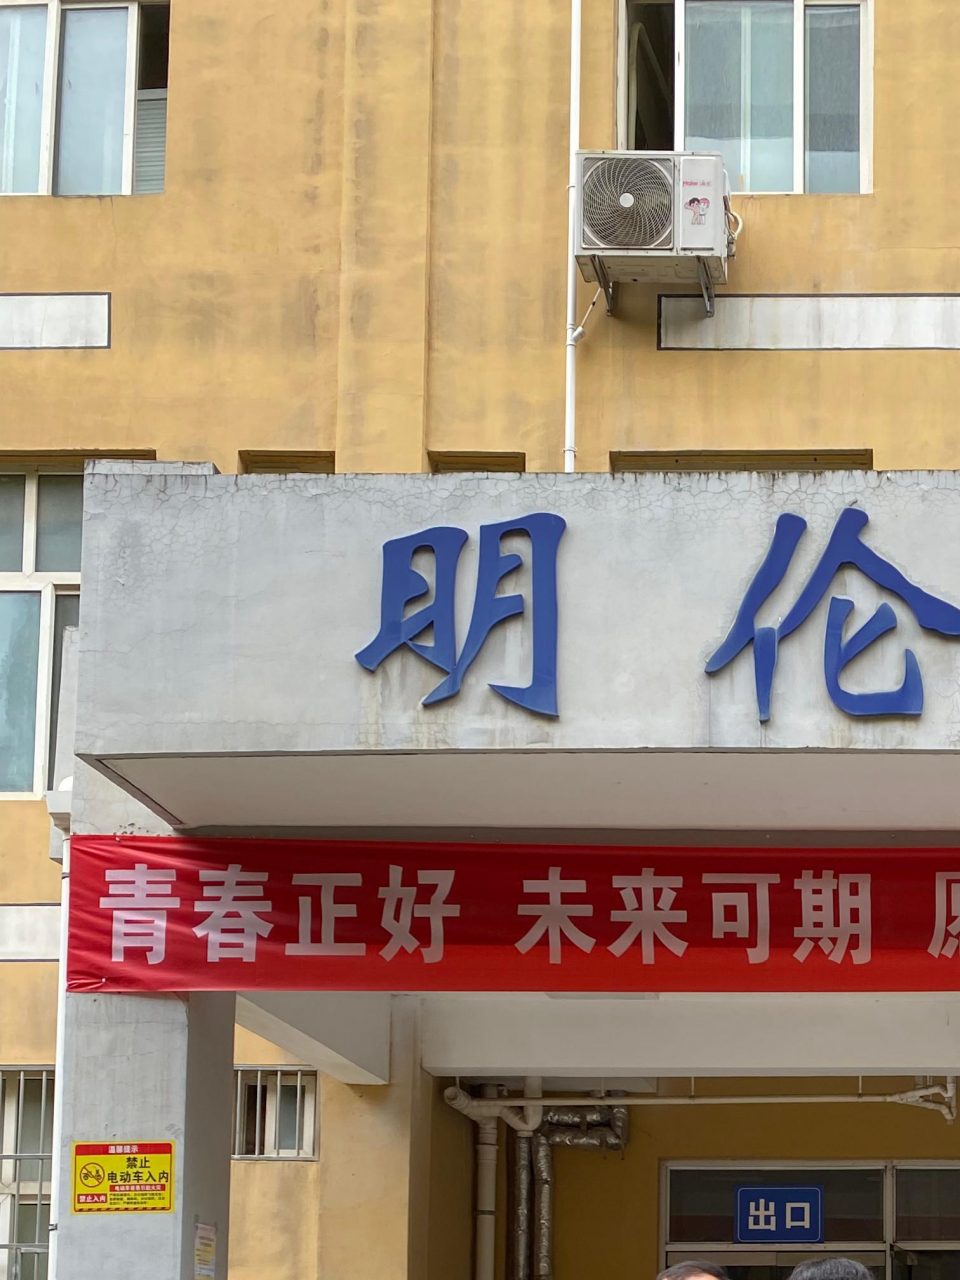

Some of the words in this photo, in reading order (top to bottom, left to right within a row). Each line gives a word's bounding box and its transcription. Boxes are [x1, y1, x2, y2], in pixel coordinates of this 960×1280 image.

[99, 863, 461, 966] 青春正好
[514, 866, 872, 965] 未来可期
[126, 1156, 151, 1169] 禁止
[107, 1170, 169, 1184] 电动车入内
[79, 1195, 106, 1203] 禁止入内
[748, 1198, 811, 1231] 出口
